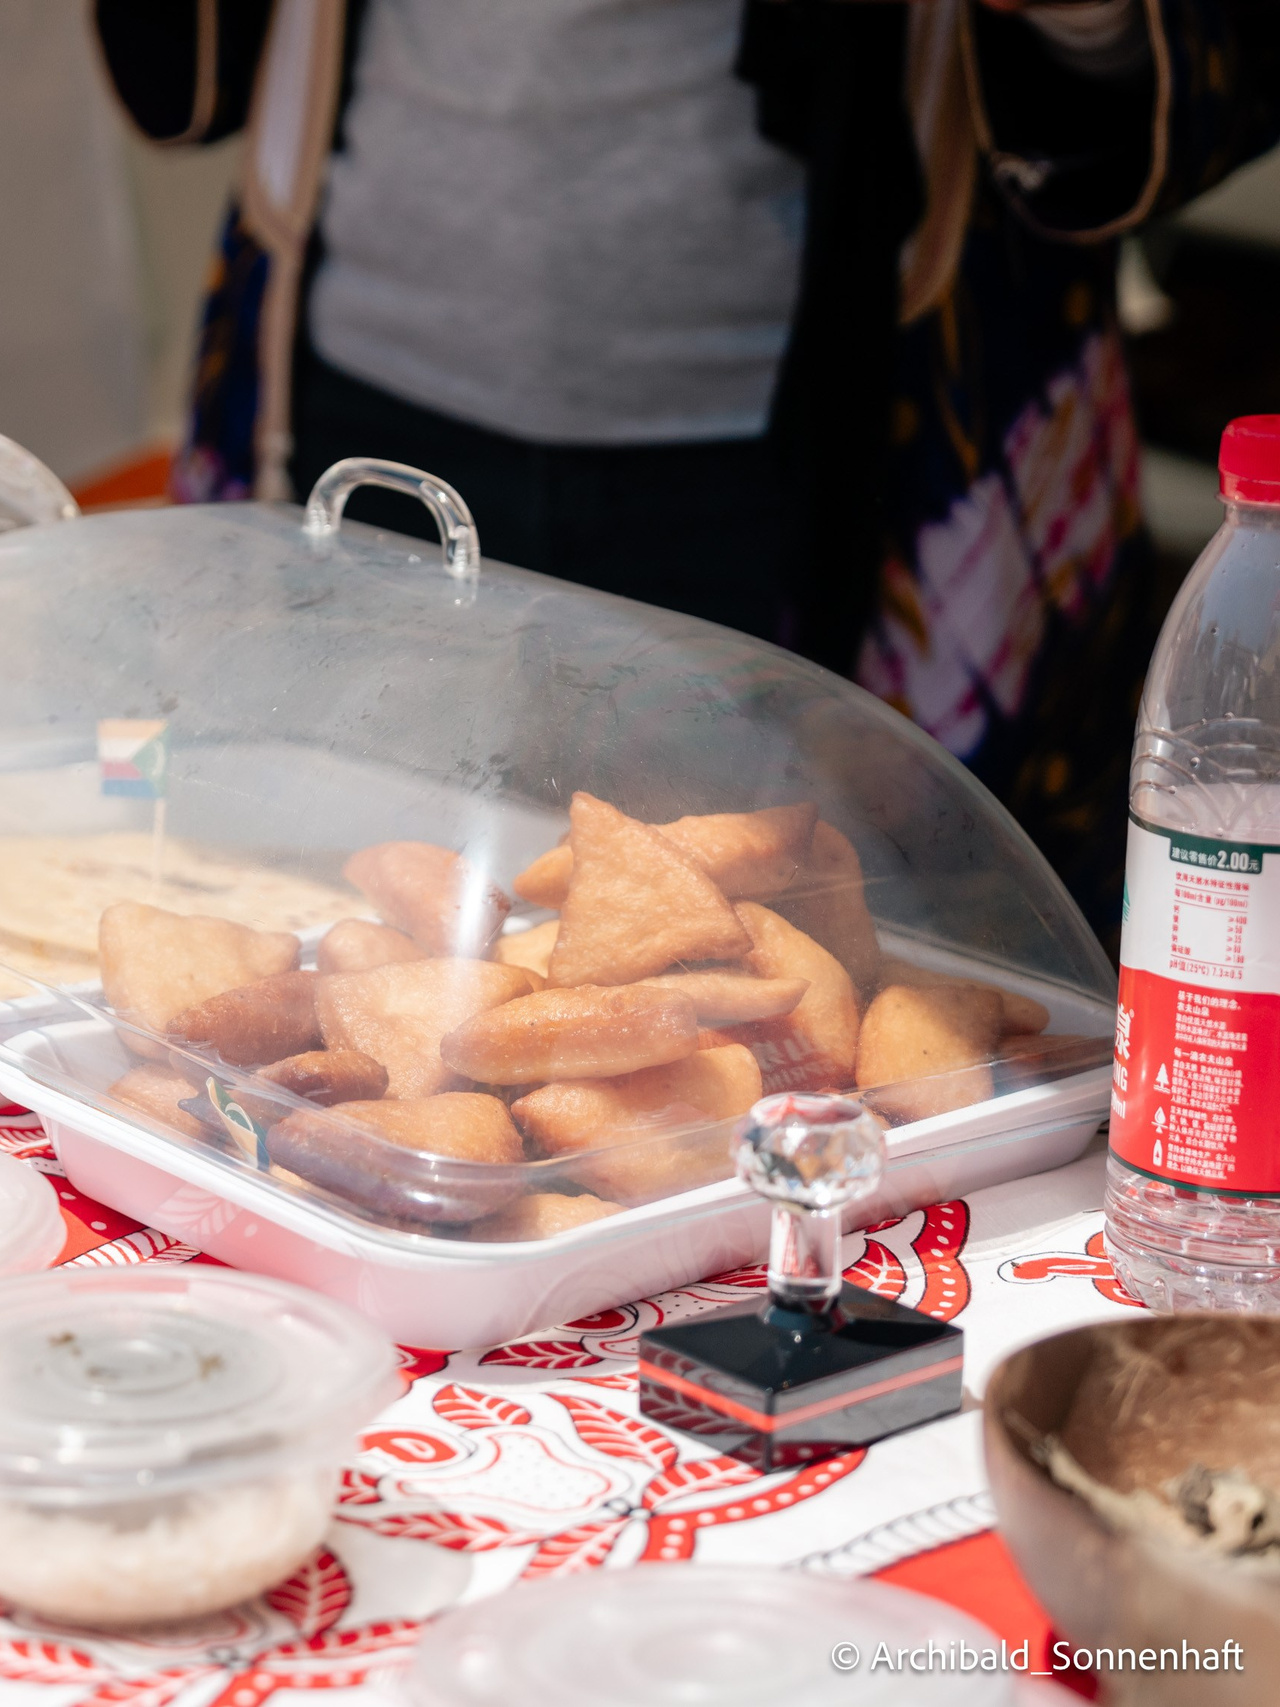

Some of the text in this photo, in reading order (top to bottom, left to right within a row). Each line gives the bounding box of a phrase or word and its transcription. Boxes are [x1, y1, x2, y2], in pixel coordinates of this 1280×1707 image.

[1171, 847, 1260, 872] 建议零售价2.00元
[1176, 1001, 1210, 1017] 农夫山泉
[1173, 1047, 1234, 1067] 每一滴农夫山泉
